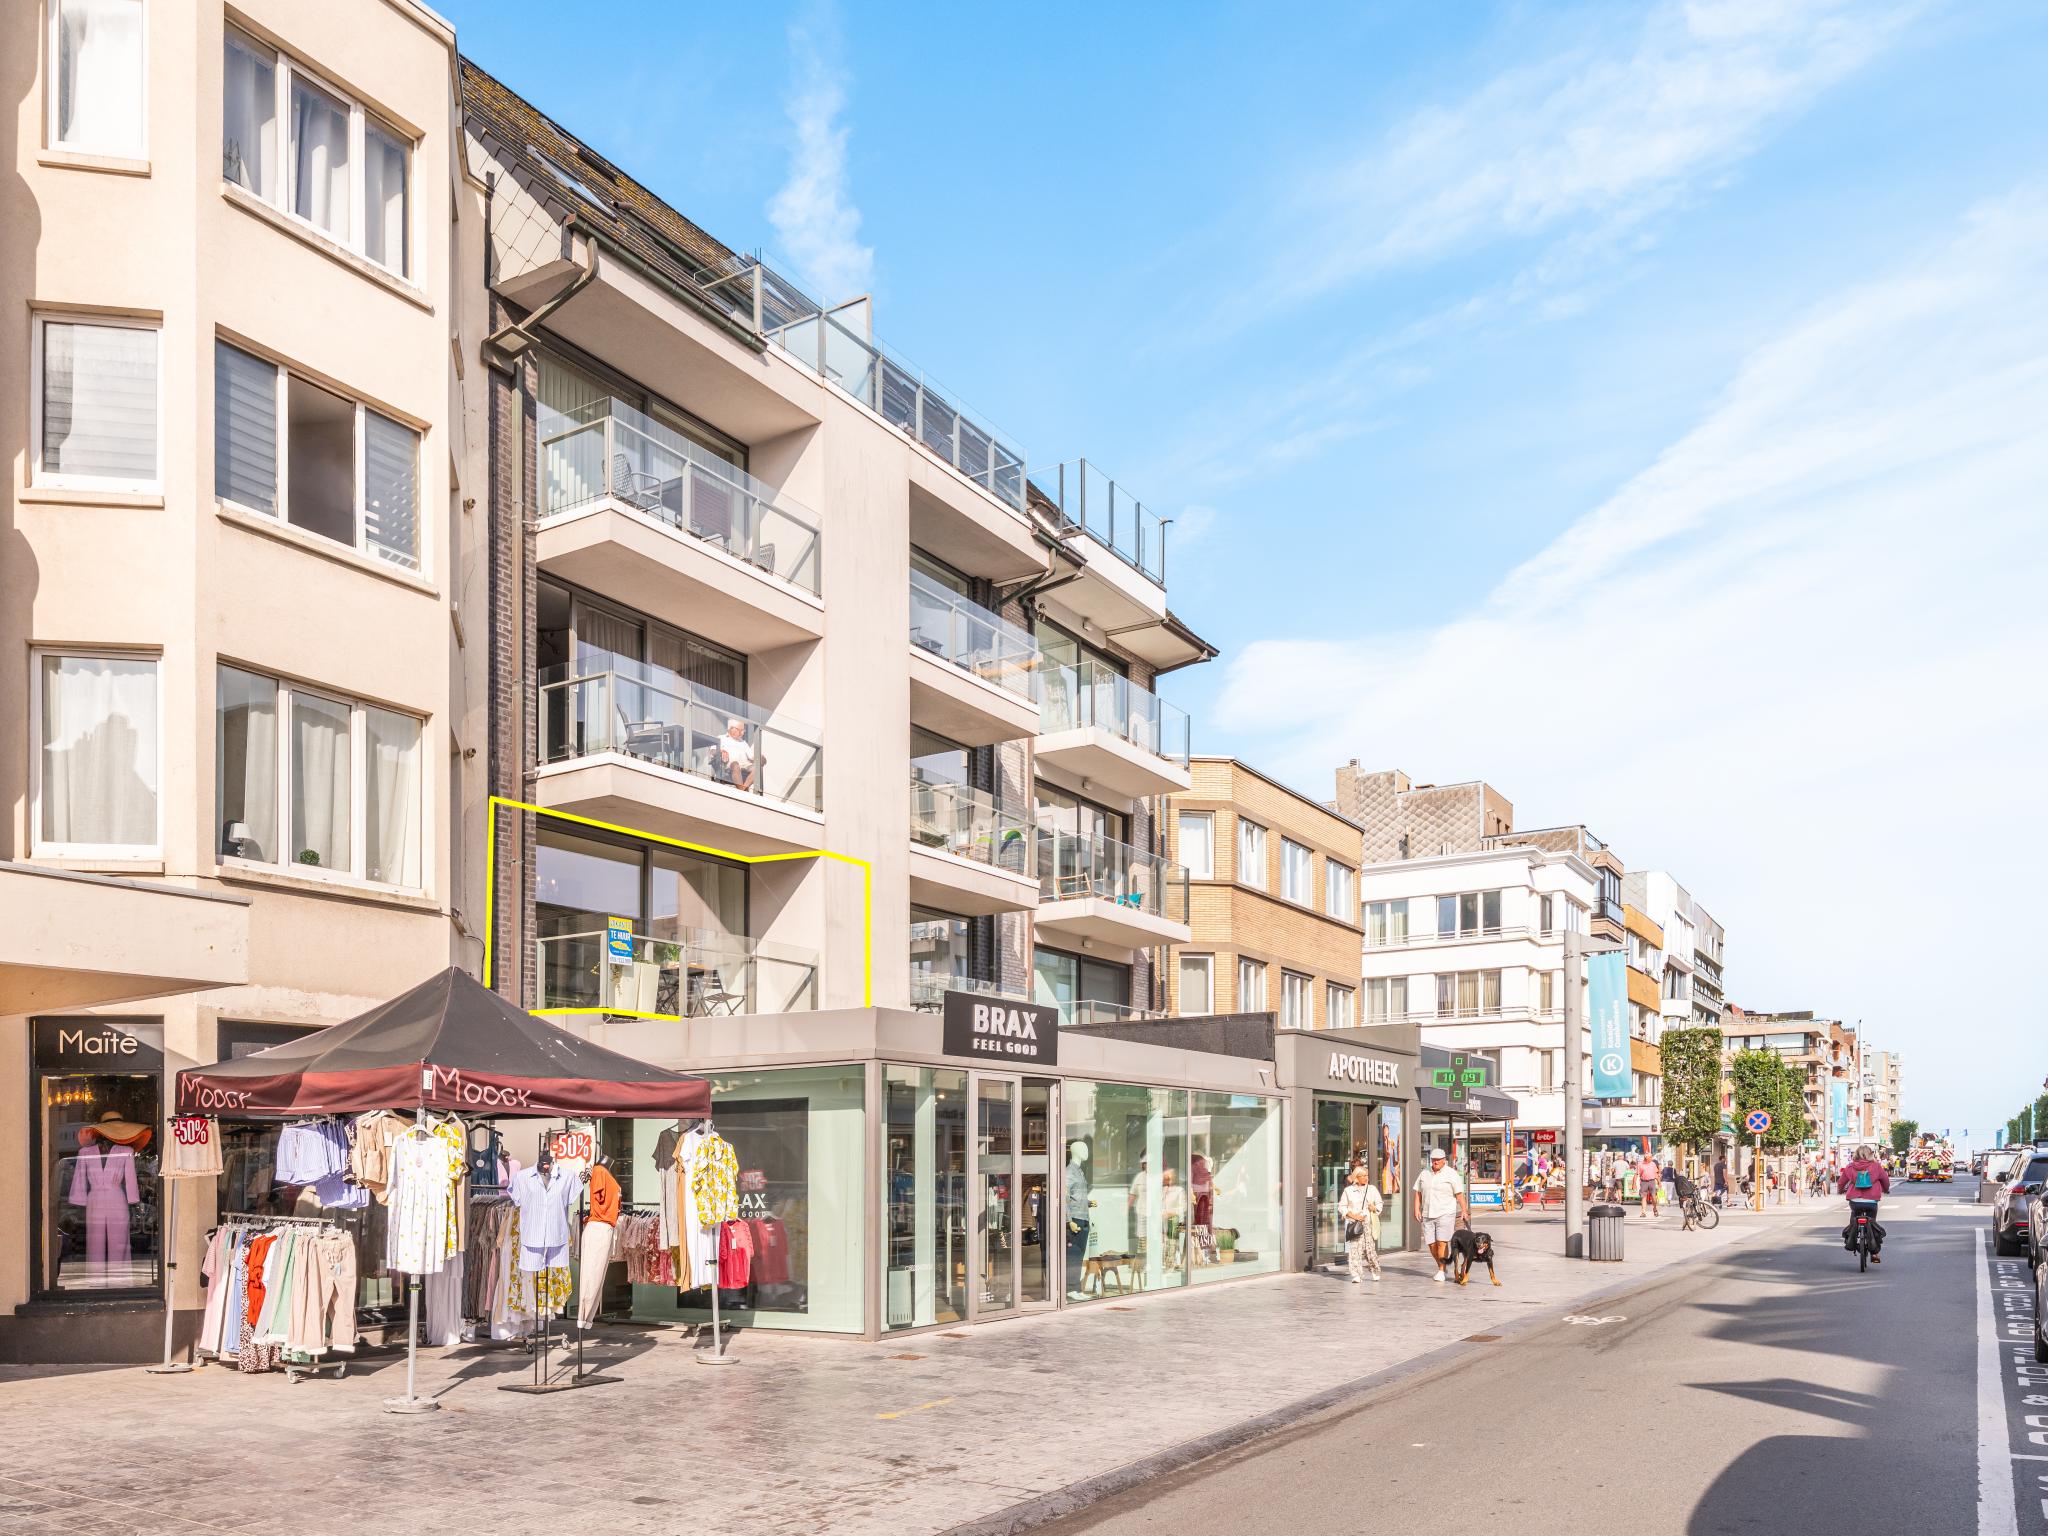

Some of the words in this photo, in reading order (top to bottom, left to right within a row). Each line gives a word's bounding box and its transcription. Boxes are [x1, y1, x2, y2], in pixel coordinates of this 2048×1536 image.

[974, 1004, 1037, 1040] BRAX
[973, 1038, 1002, 1052] FEEL
[1006, 1041, 1037, 1056] GOOD
[1329, 1052, 1399, 1086] APOTHEEK
[175, 1119, 208, 1144] -50%
[552, 1133, 590, 1158] -50%
[740, 1193, 766, 1209] AX
